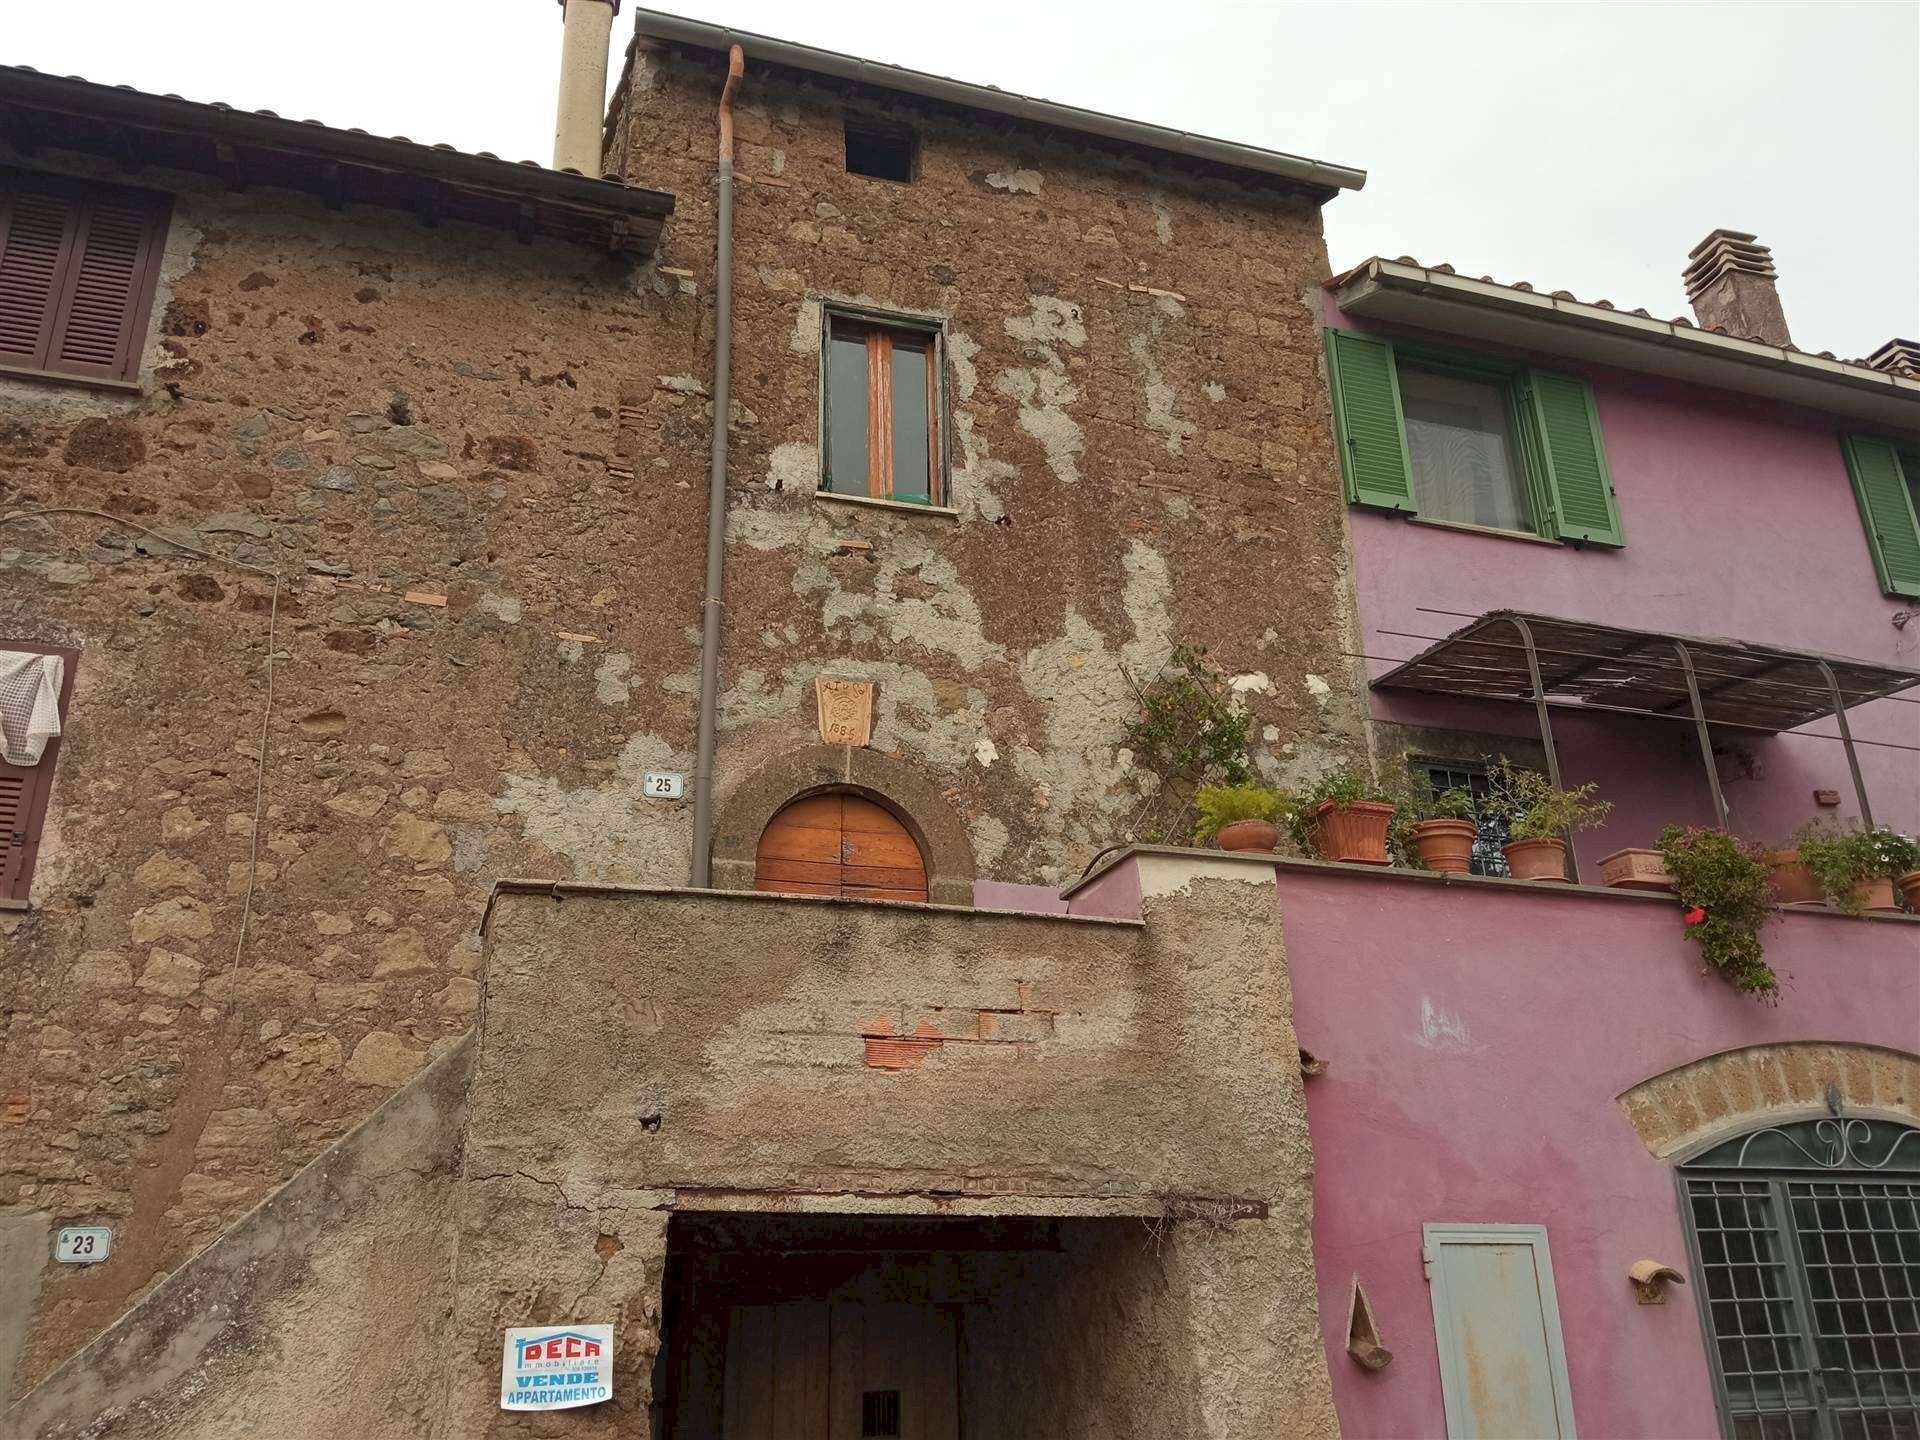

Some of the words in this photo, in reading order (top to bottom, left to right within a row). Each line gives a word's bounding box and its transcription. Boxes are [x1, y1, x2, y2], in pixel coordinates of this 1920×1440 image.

[656, 778, 671, 792] 25
[73, 1235, 94, 1254] 23
[516, 1372, 599, 1388] VENDE
[507, 1386, 606, 1404] APPARTAMENTO
